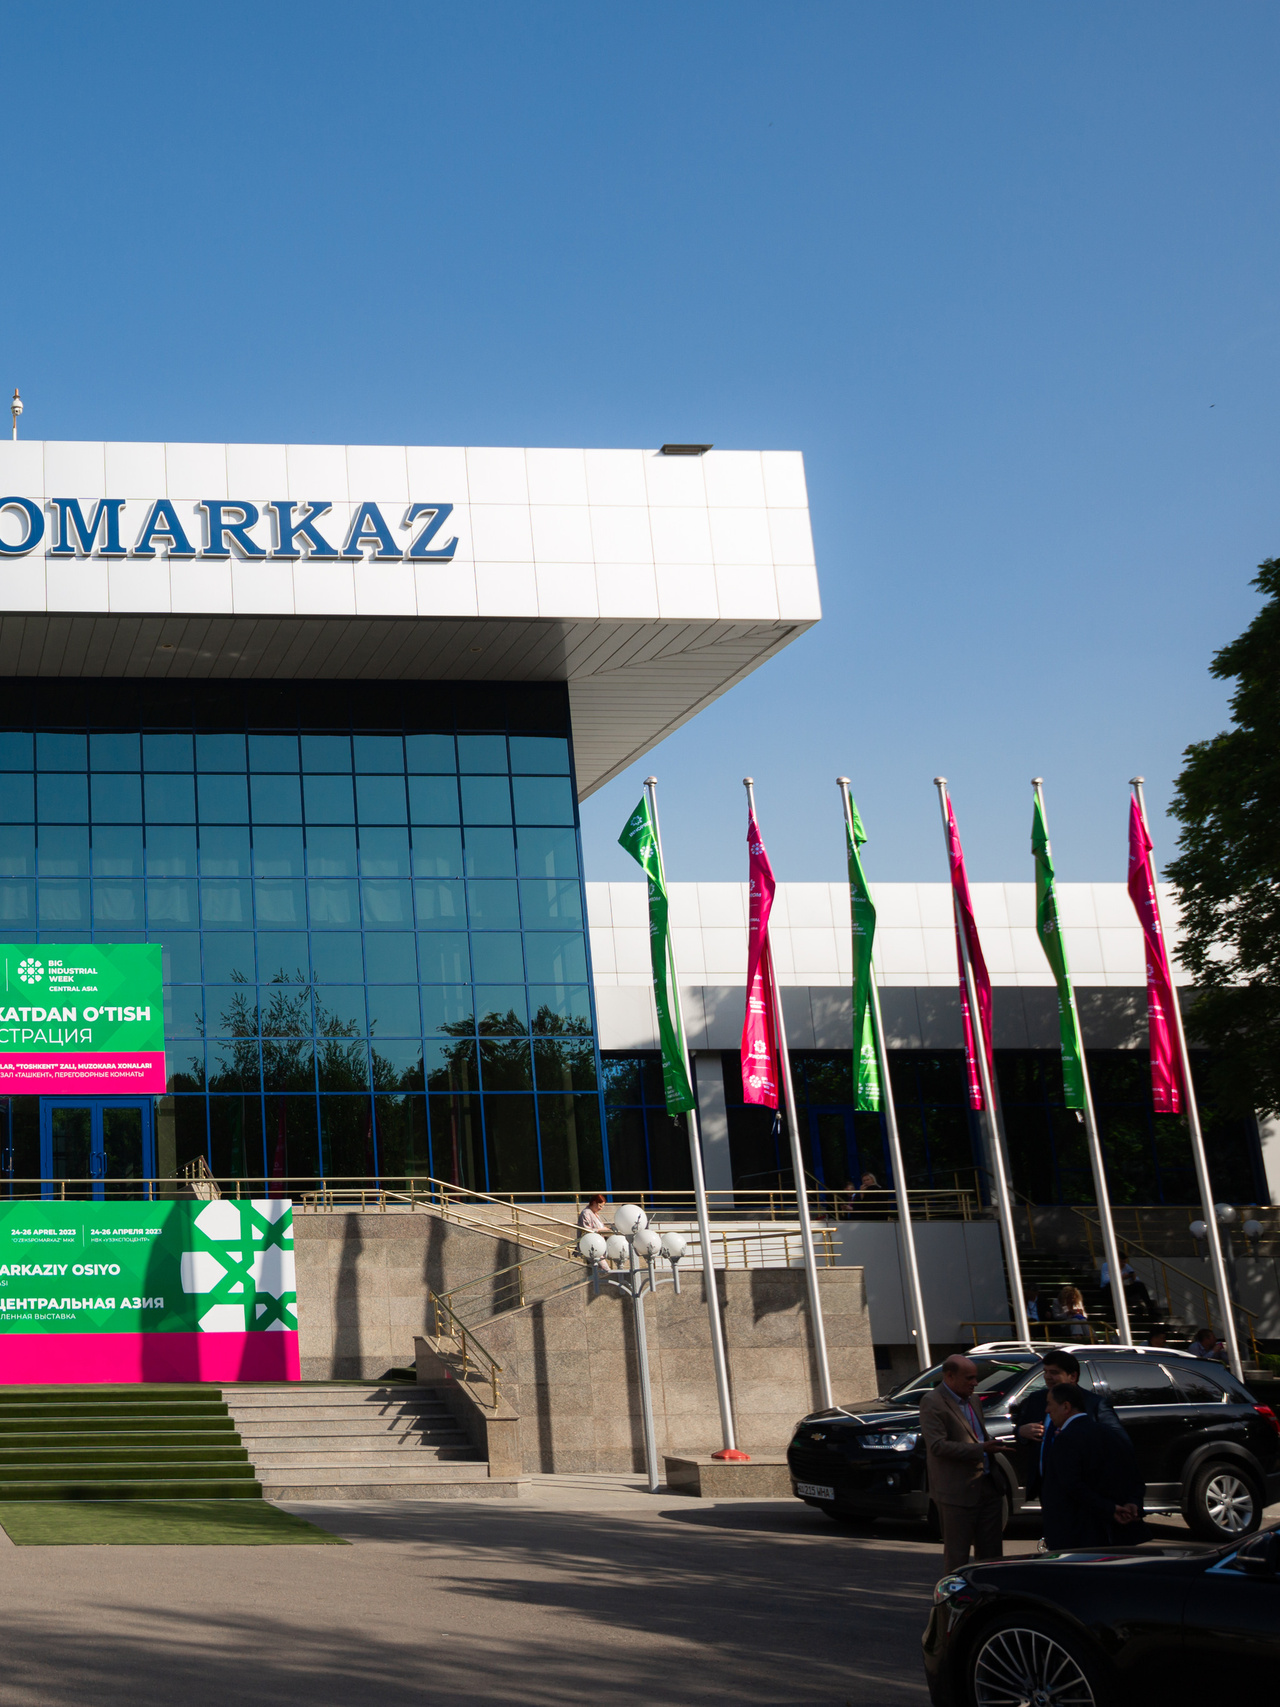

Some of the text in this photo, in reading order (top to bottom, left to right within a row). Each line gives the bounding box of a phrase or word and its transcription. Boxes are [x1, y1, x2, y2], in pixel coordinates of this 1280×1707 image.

[49, 967, 98, 975] INDUSTRIAL
[72, 1264, 120, 1276] OSIYO
[120, 1297, 164, 1309] АЗИЯ
[805, 1486, 816, 1495] 215
[817, 1488, 830, 1498] WHA
